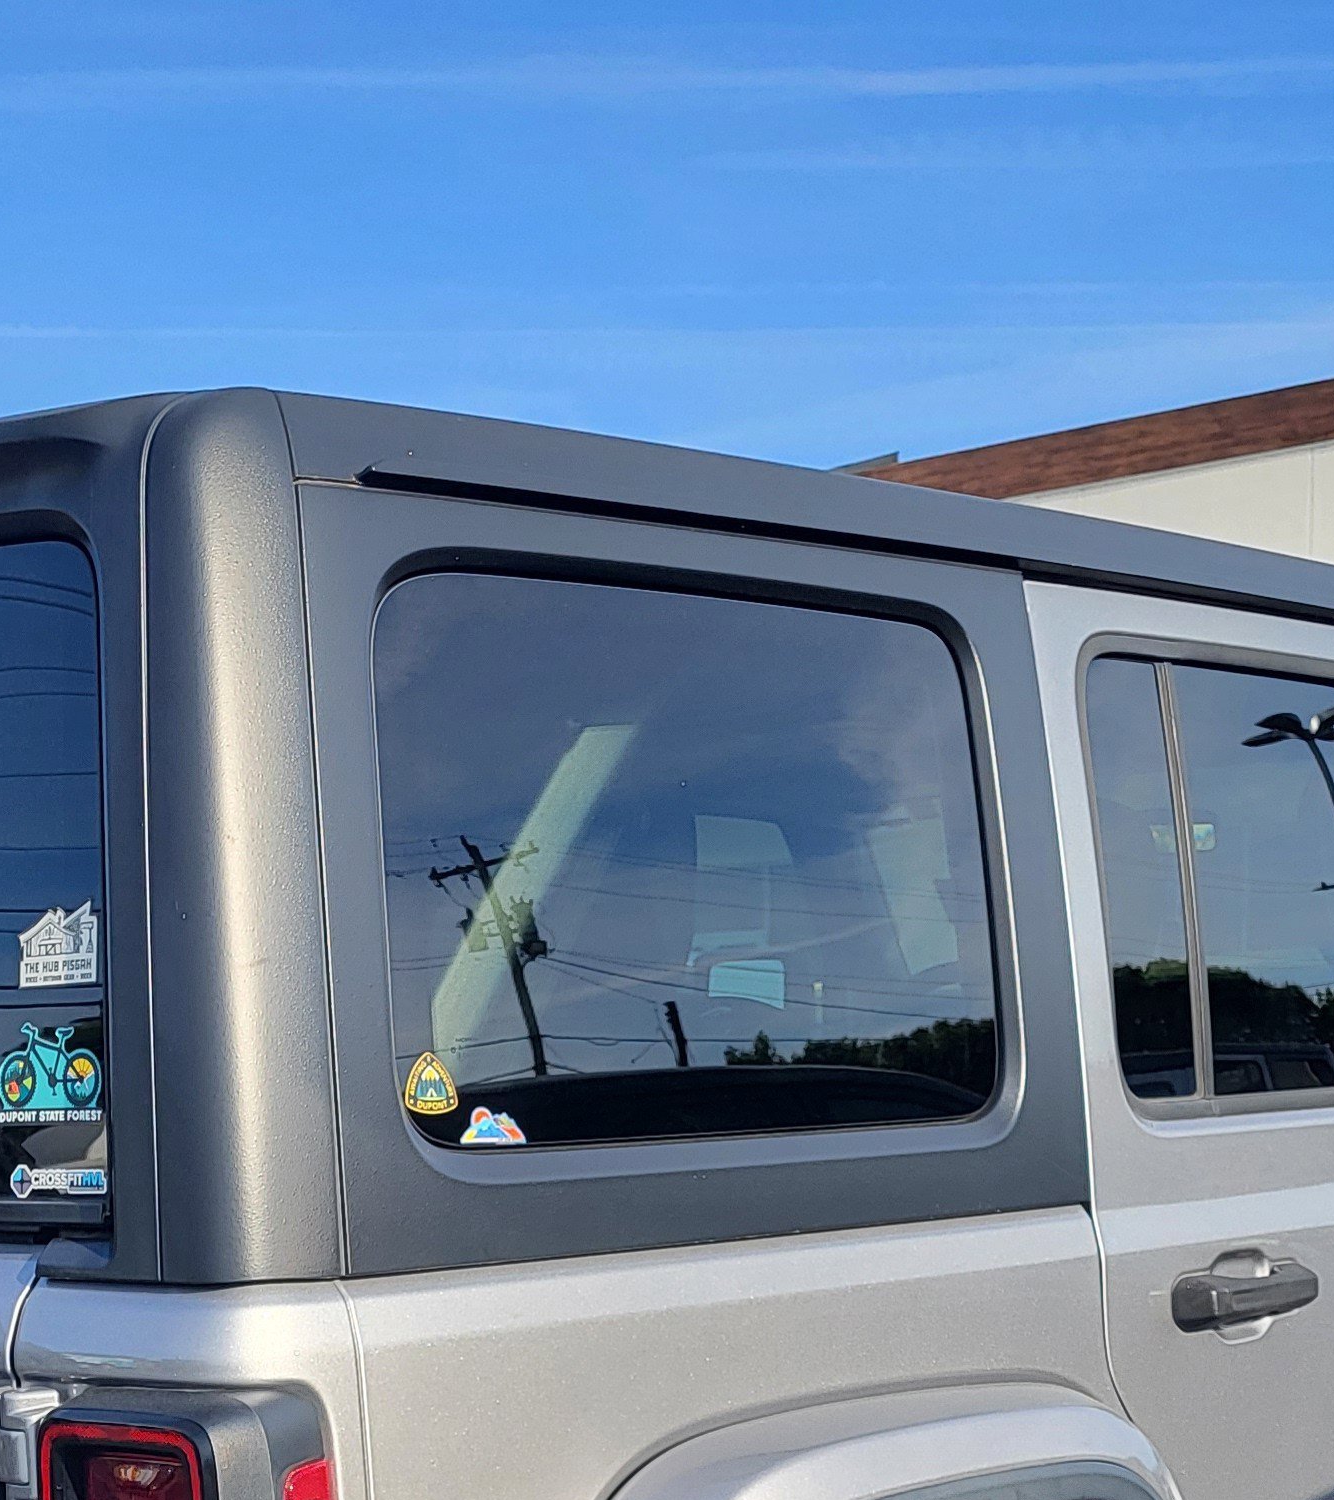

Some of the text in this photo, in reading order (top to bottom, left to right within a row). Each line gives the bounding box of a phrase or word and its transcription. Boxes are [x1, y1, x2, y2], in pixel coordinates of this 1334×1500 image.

[25, 962, 40, 974] THE
[42, 960, 60, 973] HUB
[417, 1100, 448, 1110] DUPONT
[0, 1109, 103, 1124] DUPONT STATE FOREST
